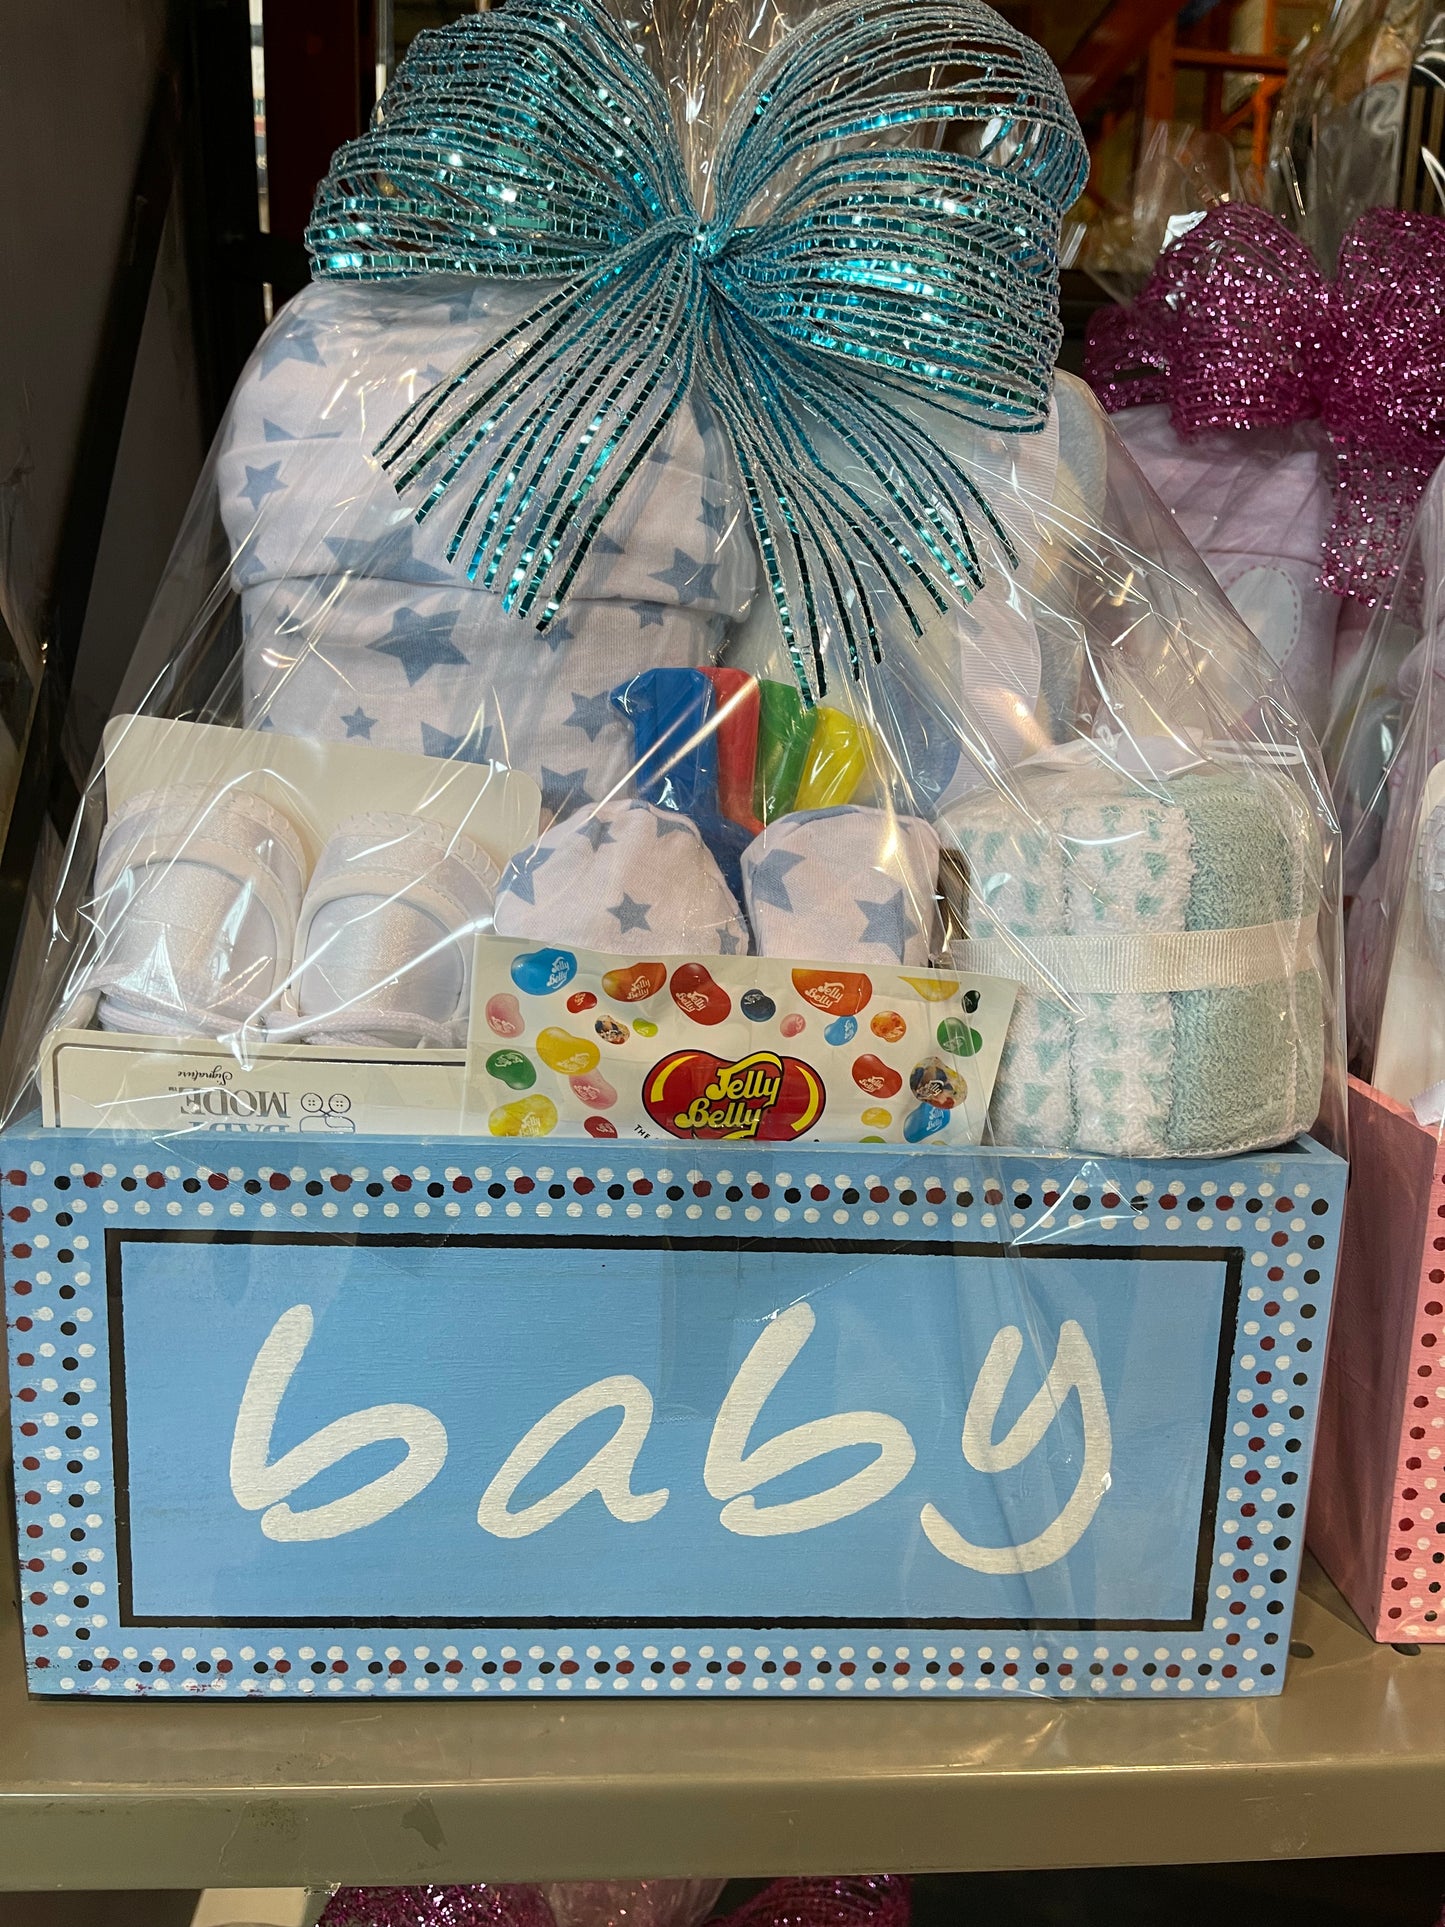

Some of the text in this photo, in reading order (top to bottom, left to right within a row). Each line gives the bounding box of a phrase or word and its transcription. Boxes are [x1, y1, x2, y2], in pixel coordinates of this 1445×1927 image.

[551, 956, 570, 975] Jelly
[627, 986, 650, 1000] Belly
[631, 975, 651, 991] Jelly
[817, 981, 845, 1003] Jelly
[675, 992, 696, 1013] Belly
[687, 991, 709, 1011] Jelly
[805, 988, 834, 1009] Belly
[178, 1065, 233, 1086] Signature
[705, 1051, 783, 1107] Jelly
[178, 1086, 292, 1119] MODE
[674, 1097, 762, 1139] Belly
[634, 1124, 651, 1139] THE
[229, 1302, 1113, 1575] baby
